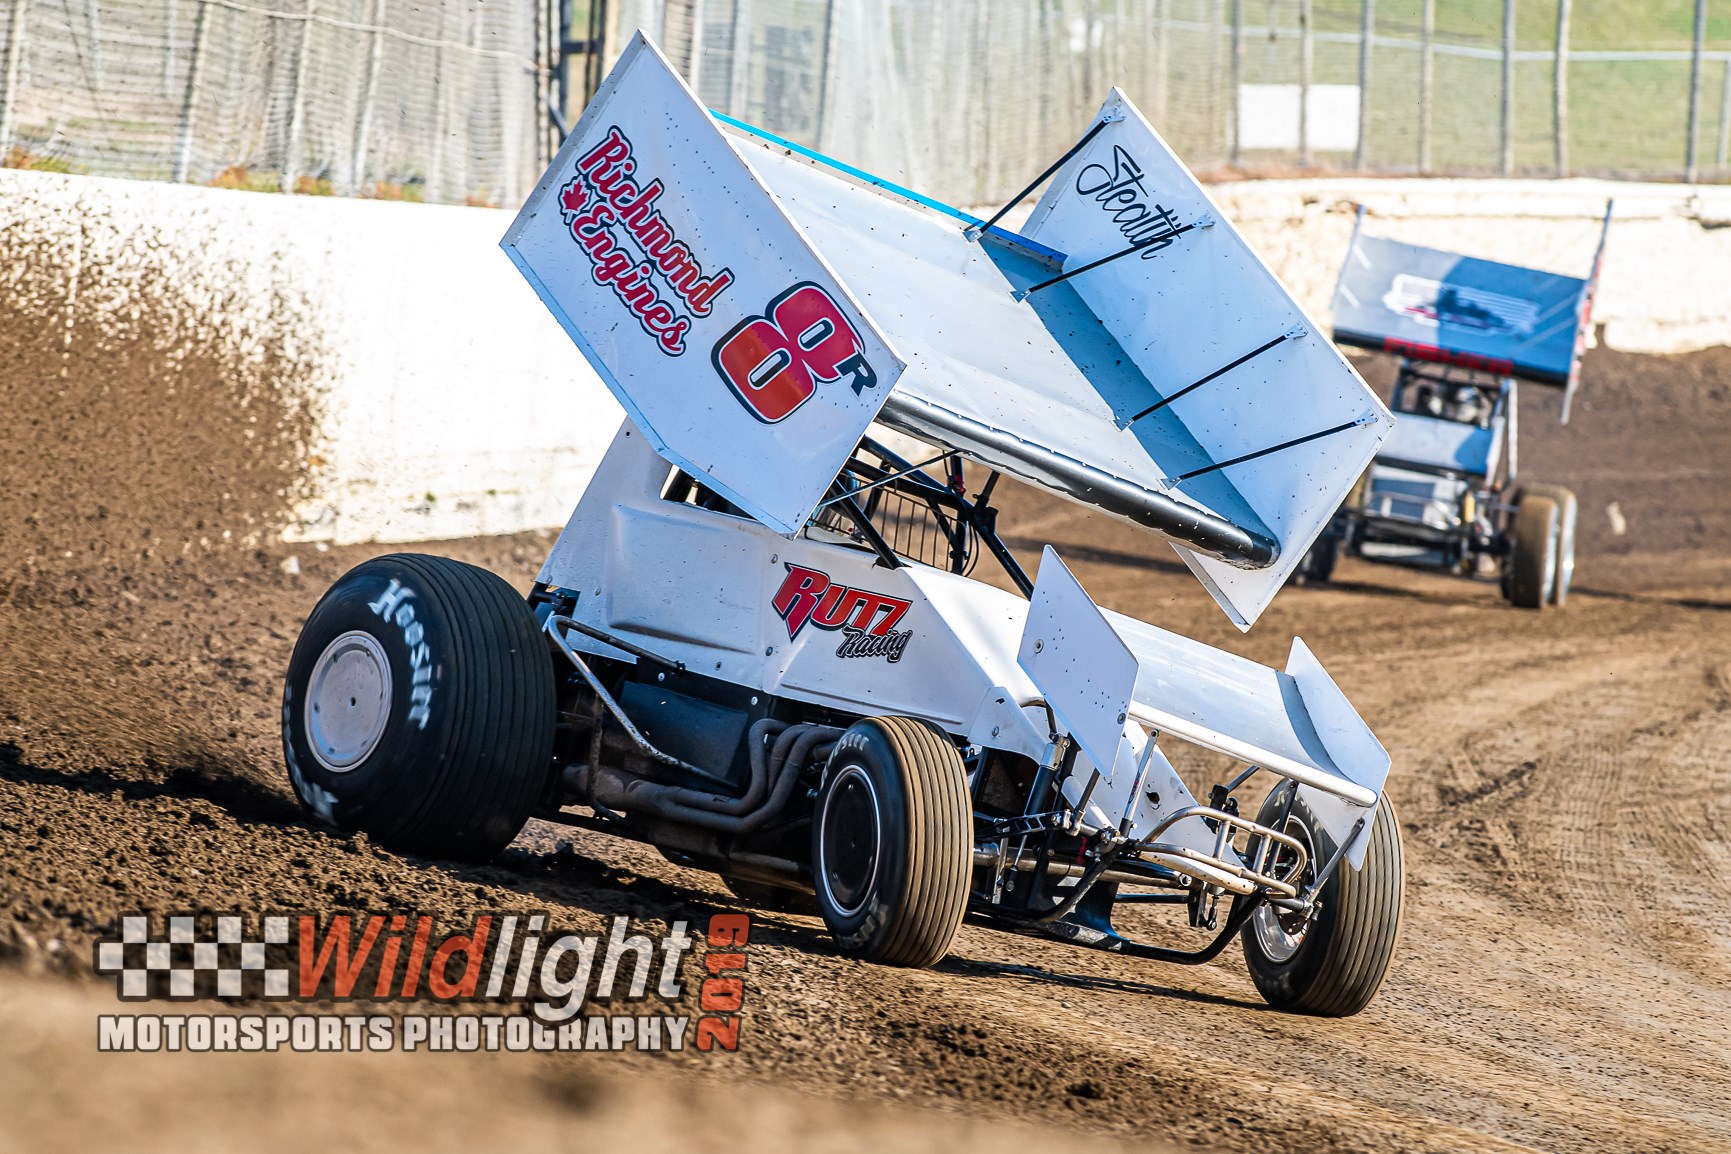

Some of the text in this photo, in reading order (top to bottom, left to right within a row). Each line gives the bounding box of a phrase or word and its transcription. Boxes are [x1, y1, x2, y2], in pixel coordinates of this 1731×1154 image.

[576, 125, 735, 318] Richmond
[1076, 144, 1181, 260] Stealth
[569, 202, 691, 357] Engines
[836, 623, 913, 663] Racing
